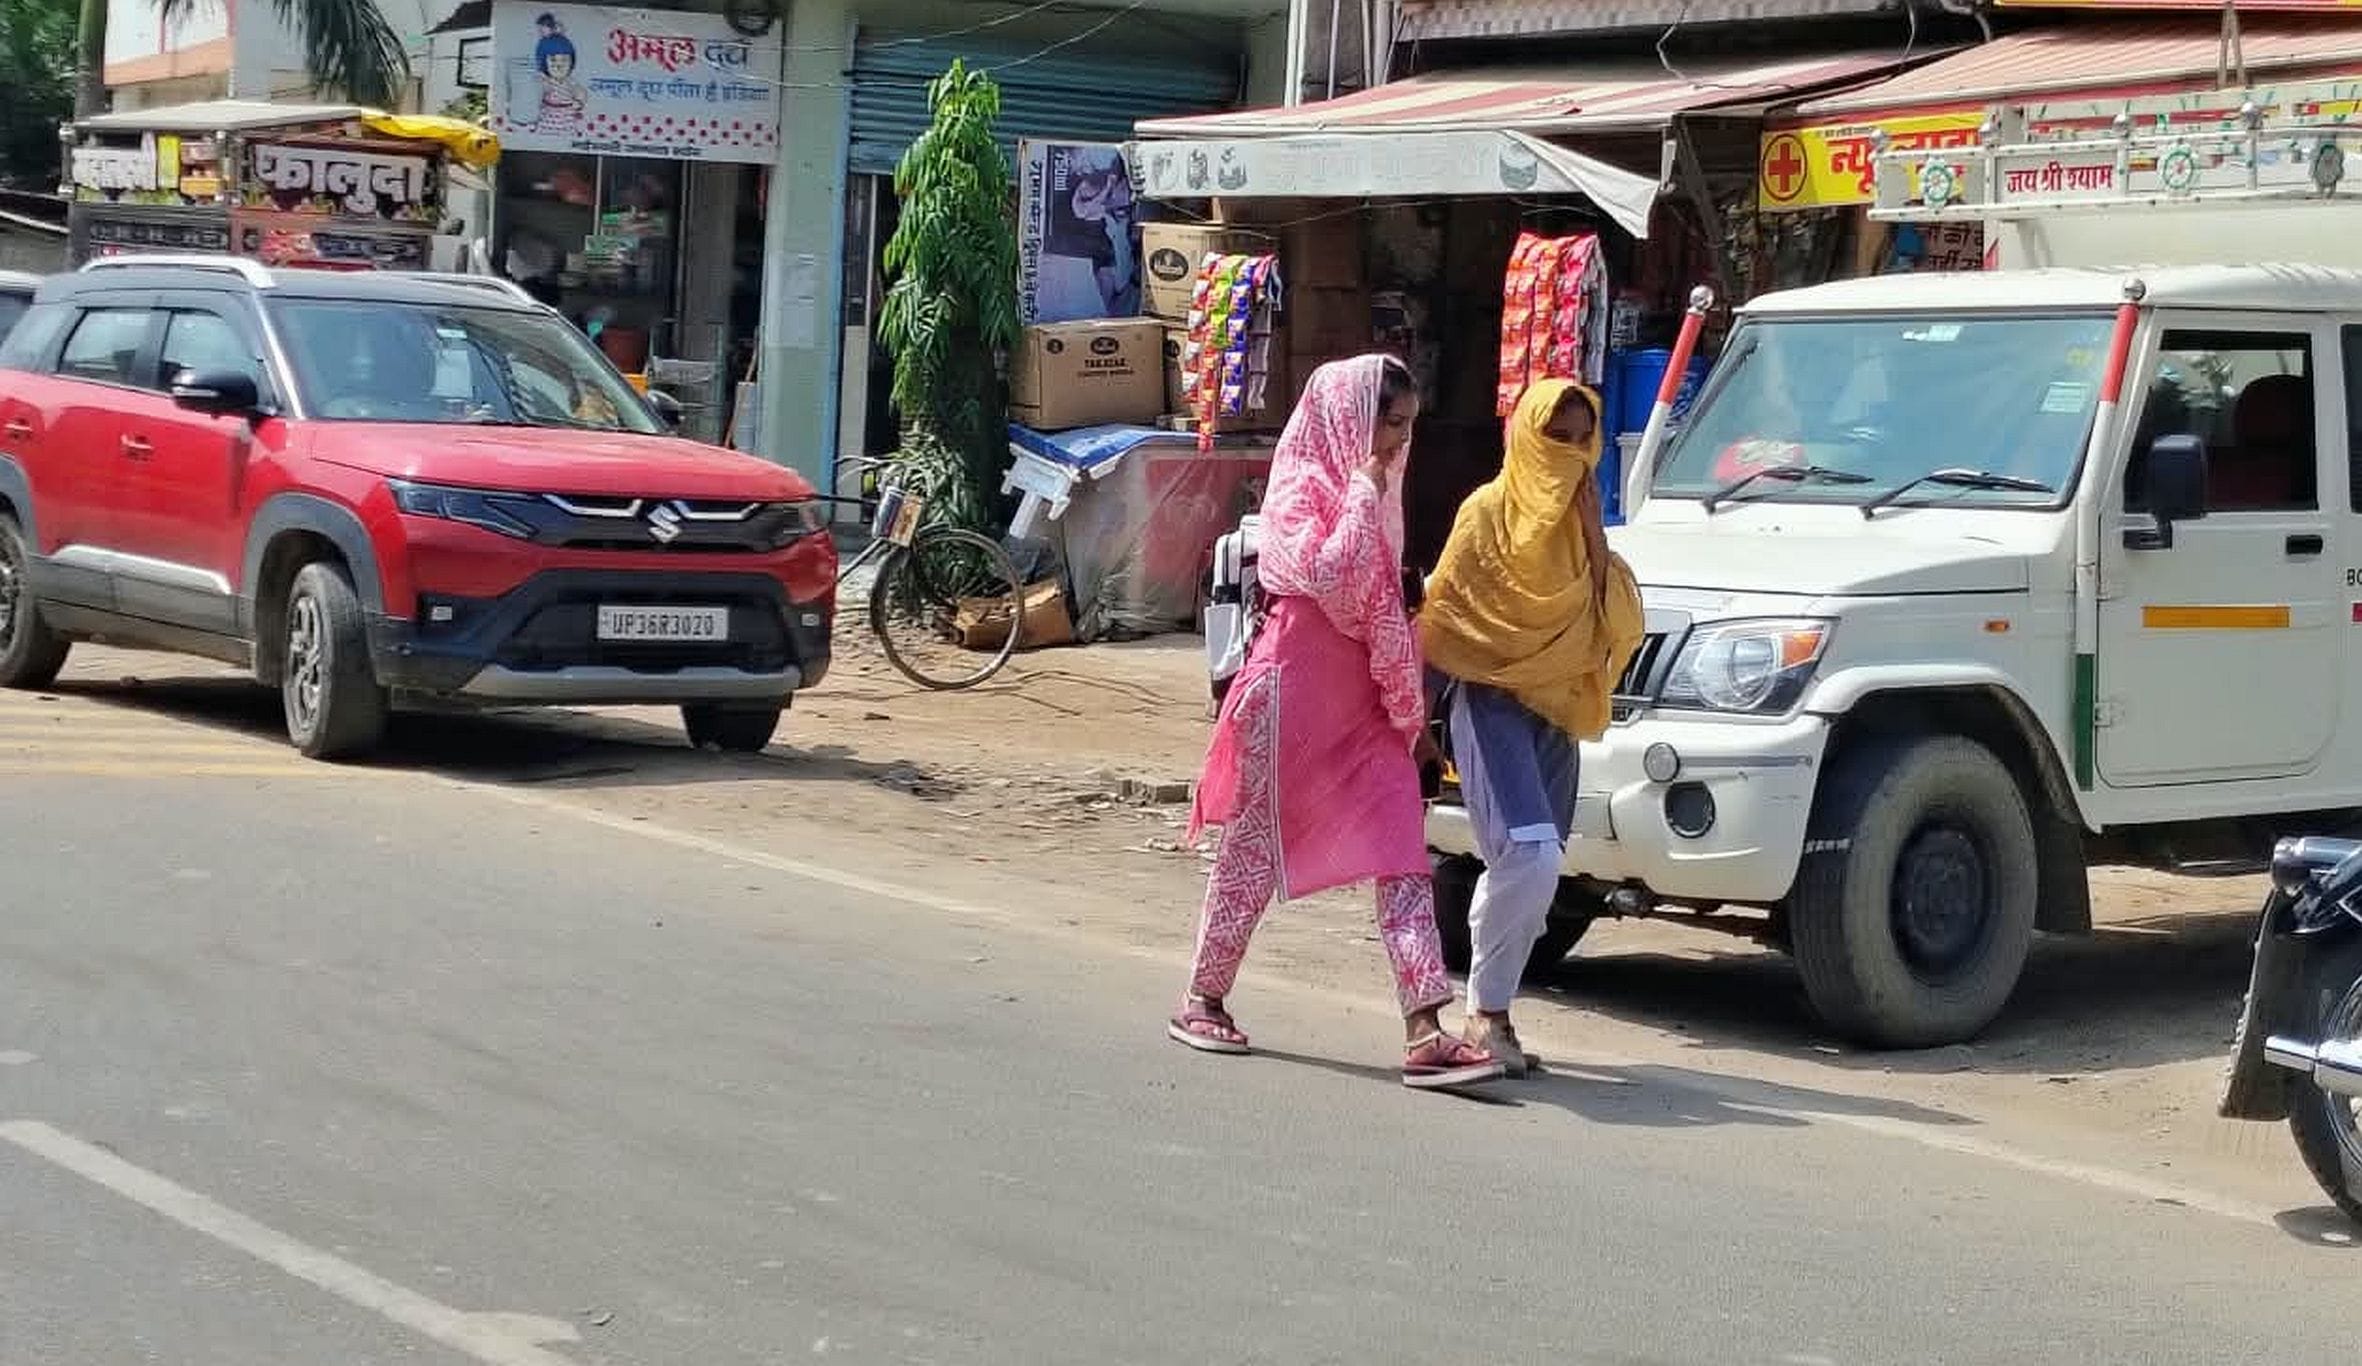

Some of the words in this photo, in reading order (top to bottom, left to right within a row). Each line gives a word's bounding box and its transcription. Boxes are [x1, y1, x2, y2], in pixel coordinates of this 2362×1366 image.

[255, 144, 427, 214] फालुदा
[2005, 168, 2037, 192] जय
[2040, 161, 2062, 192] श्री
[2067, 164, 2114, 191] श्याम
